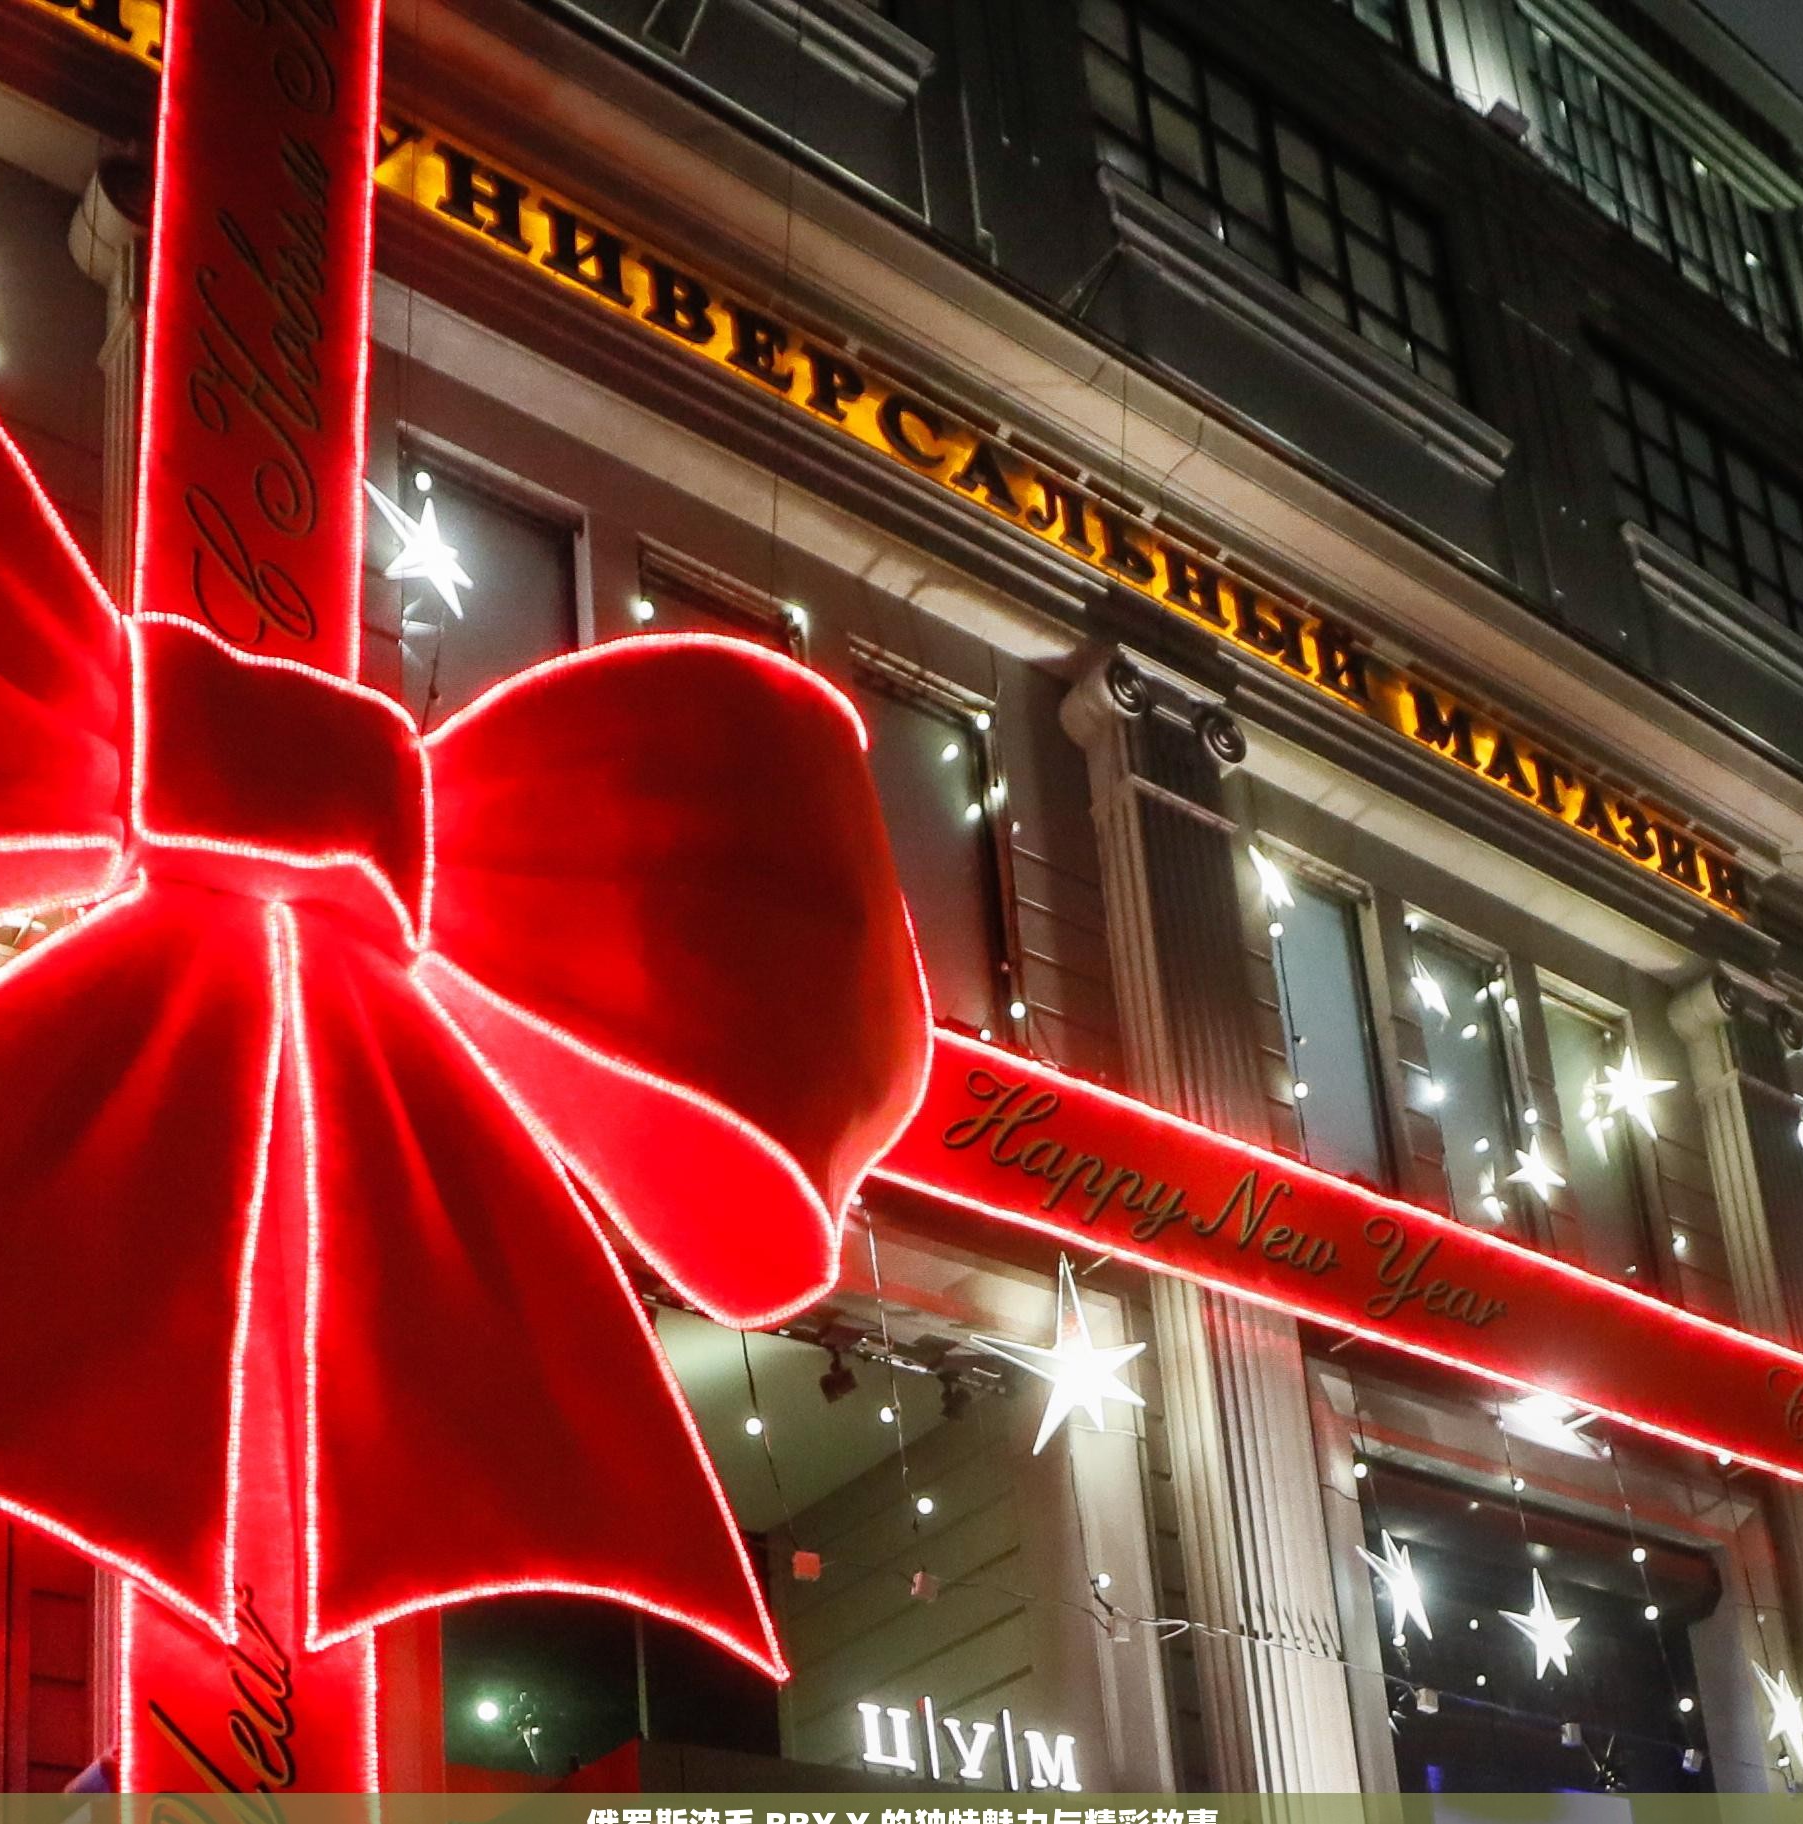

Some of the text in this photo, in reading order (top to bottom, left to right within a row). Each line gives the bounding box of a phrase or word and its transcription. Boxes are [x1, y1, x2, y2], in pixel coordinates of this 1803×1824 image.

[1412, 682, 1748, 914] МАГАЗИН
[942, 1068, 1510, 1329] Happy New Year
